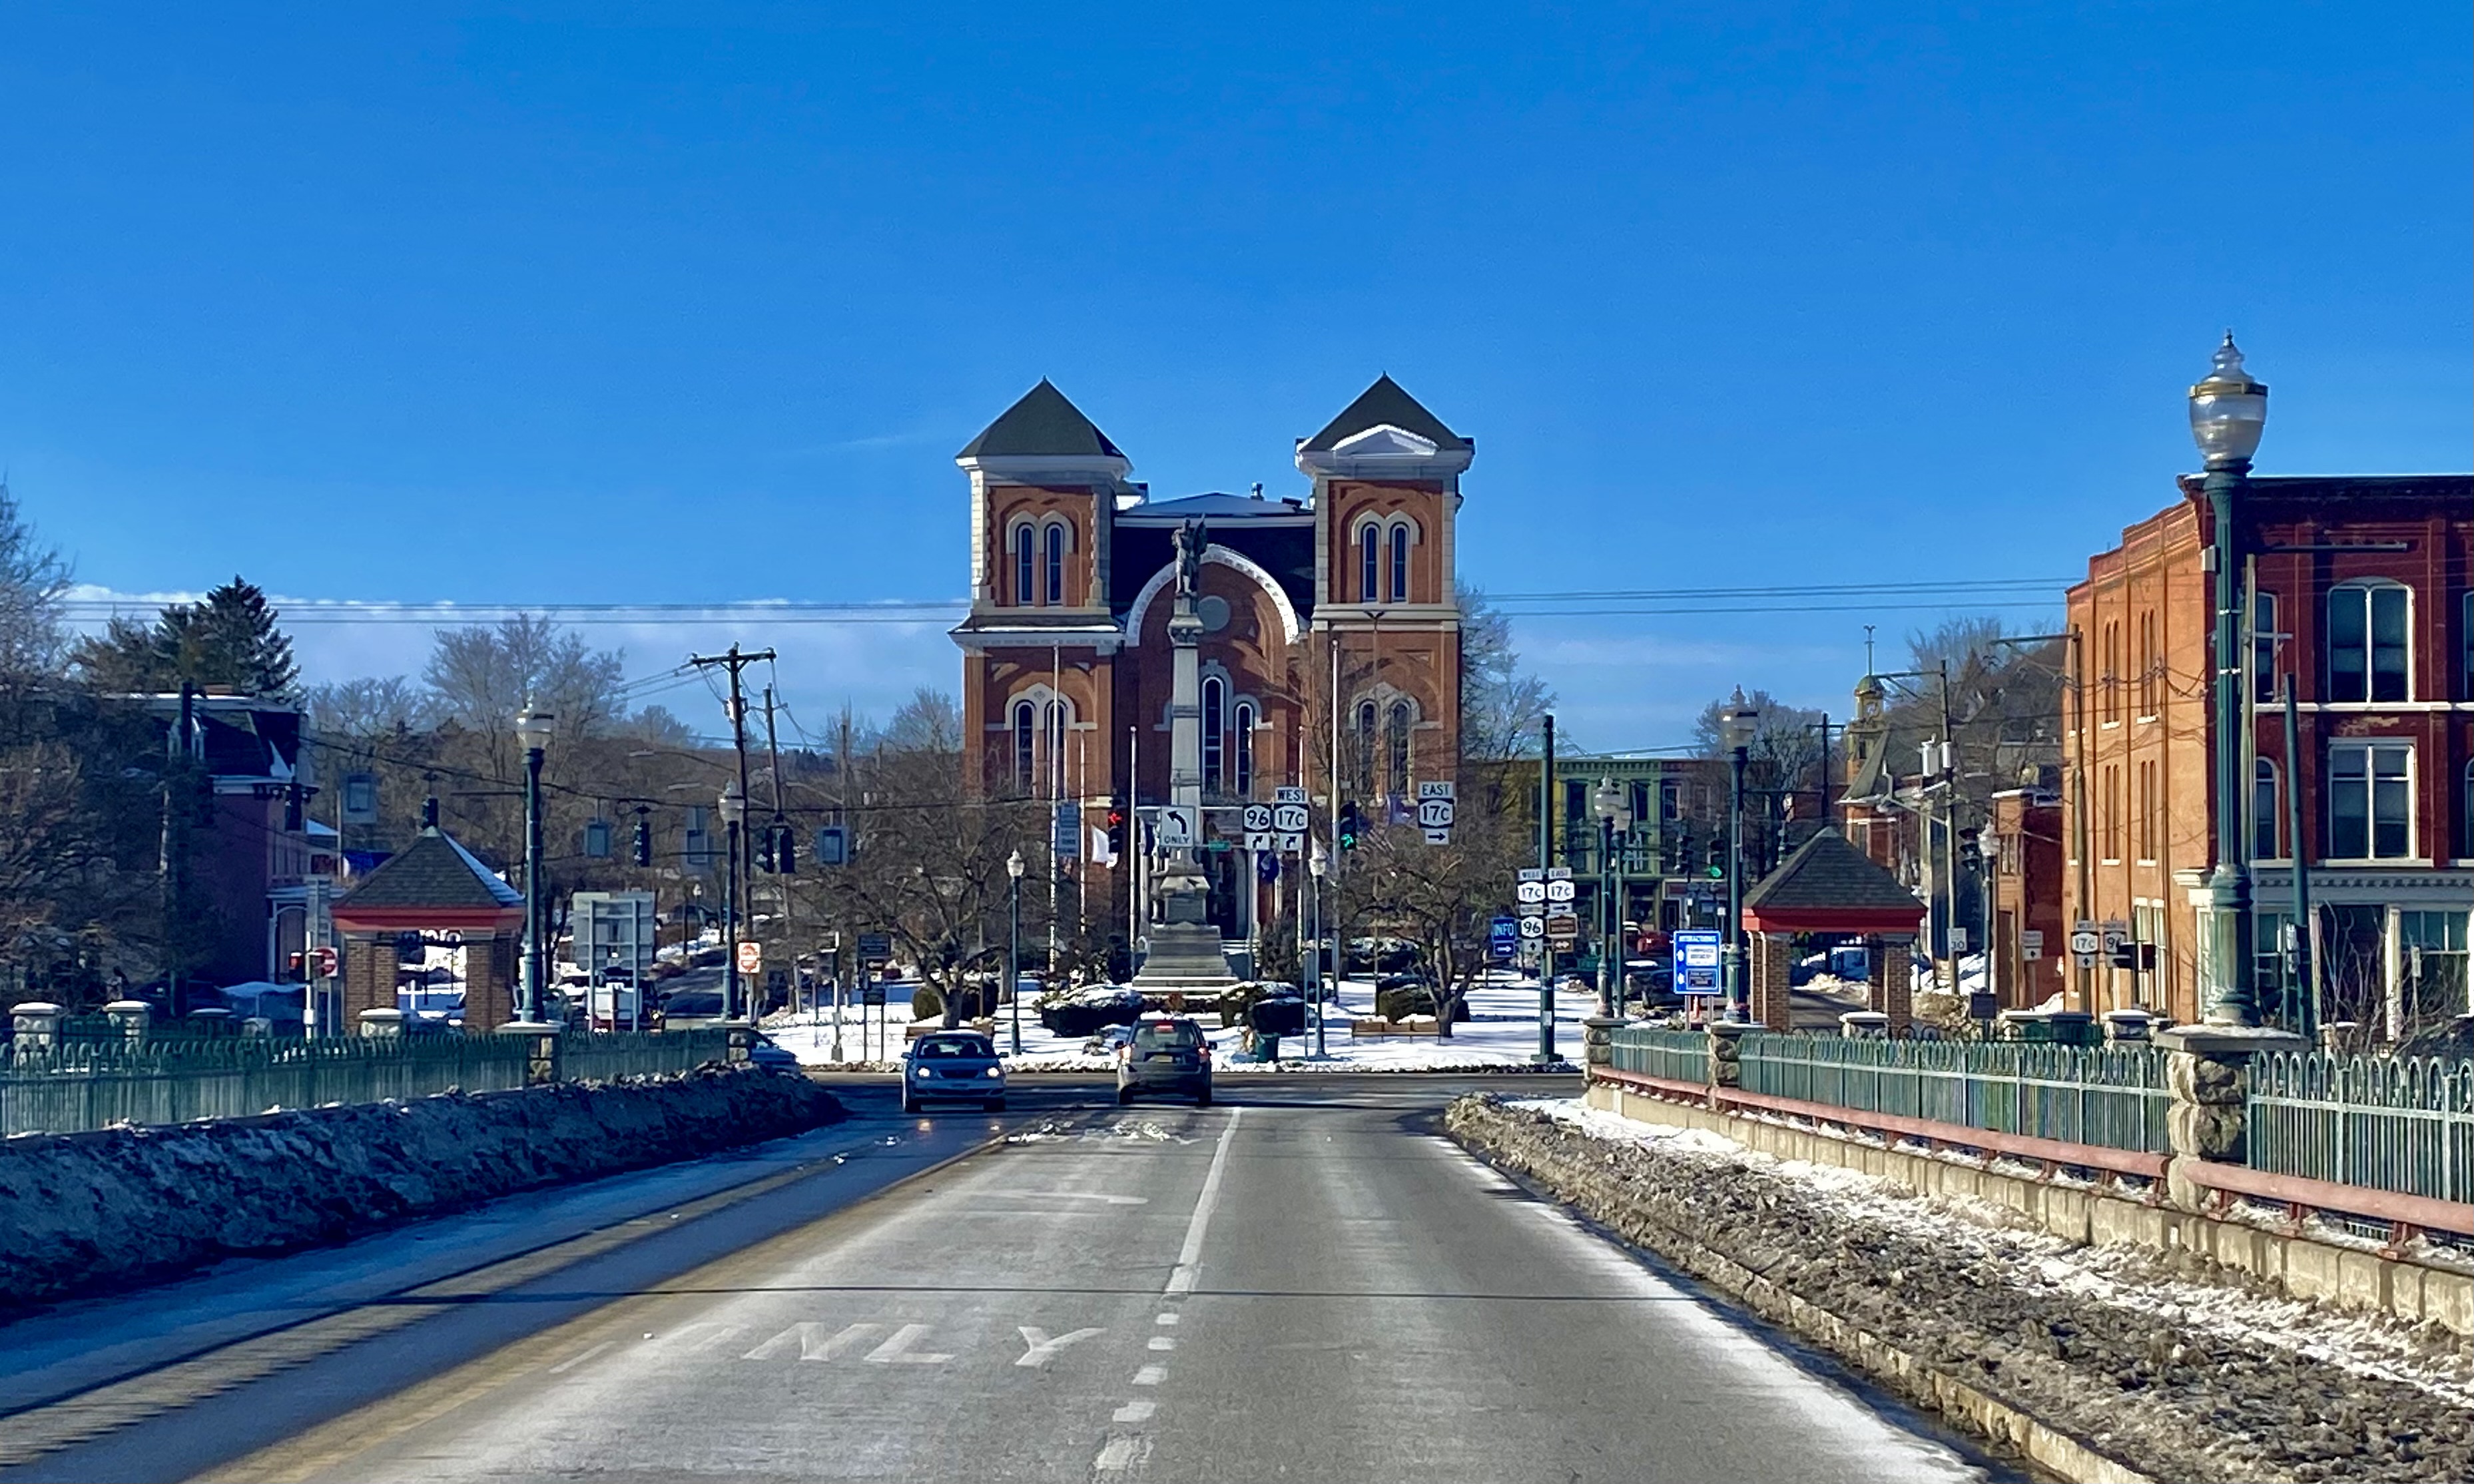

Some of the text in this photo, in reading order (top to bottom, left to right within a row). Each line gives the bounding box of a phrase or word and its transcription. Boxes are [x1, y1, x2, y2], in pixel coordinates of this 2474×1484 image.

[1277, 790, 1305, 801] WEST
[1422, 784, 1450, 796] EAST
[1246, 810, 1269, 826] 96
[1278, 810, 1305, 827] 17C
[1422, 805, 1450, 822] 17C
[1521, 887, 1542, 898] 17C
[1551, 885, 1571, 897] 17C
[1493, 923, 1514, 936] INFO
[1523, 921, 1541, 933] 96
[1950, 940, 1965, 950] 30
[2074, 937, 2095, 949] 17C
